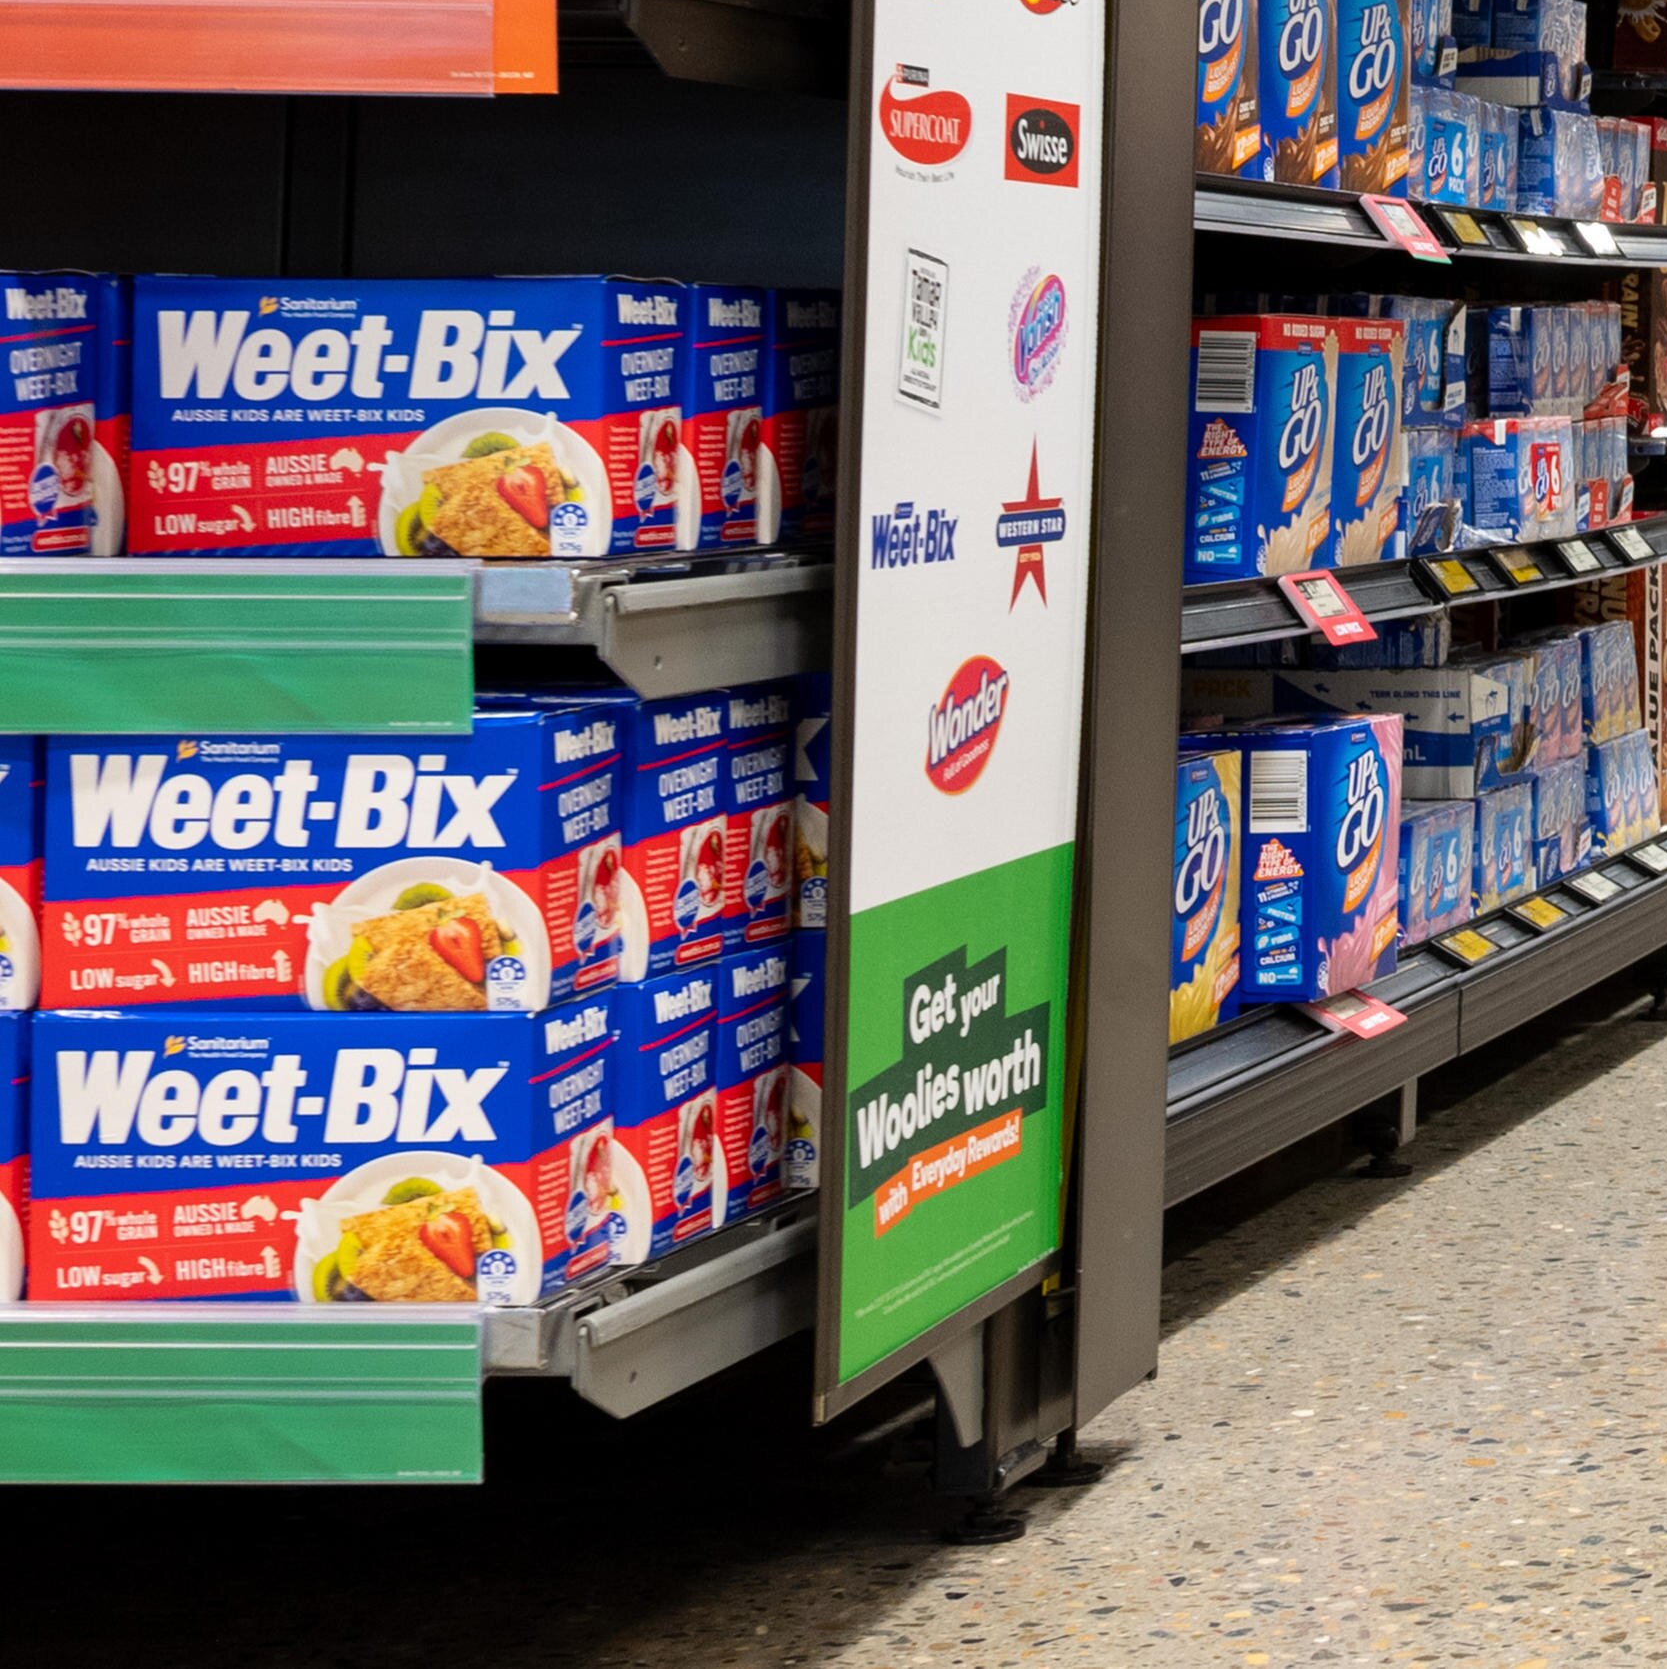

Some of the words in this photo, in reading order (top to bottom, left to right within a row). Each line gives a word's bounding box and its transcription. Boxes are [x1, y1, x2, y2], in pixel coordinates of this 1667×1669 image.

[889, 109, 961, 146] SUPERCOAT
[5, 287, 87, 320] Weet-Bix
[280, 297, 358, 312] Sanitarium
[9, 341, 82, 374] OVERNIGHT
[158, 310, 582, 402] Weet-Bix
[172, 409, 228, 422] AUSSIE
[231, 409, 269, 422] KIDS
[272, 409, 303, 422] ARE
[307, 409, 383, 422] WEET-BIX
[386, 409, 425, 422] KIDS
[266, 454, 327, 475] AUSSIE
[267, 507, 315, 529] HIGH
[316, 509, 351, 527] fibre
[998, 518, 1039, 539] WESTERN
[1041, 515, 1063, 534] STAR
[872, 508, 958, 569] Weet-Bix
[929, 669, 1009, 769] Wonder
[909, 973, 956, 1044] Get
[959, 974, 1000, 1037] your
[857, 1062, 960, 1169] Woolies
[963, 1028, 1041, 1116] worth
[879, 1176, 908, 1225] with
[911, 1143, 968, 1192] Everyday
[967, 1116, 1019, 1165] Rewards!
